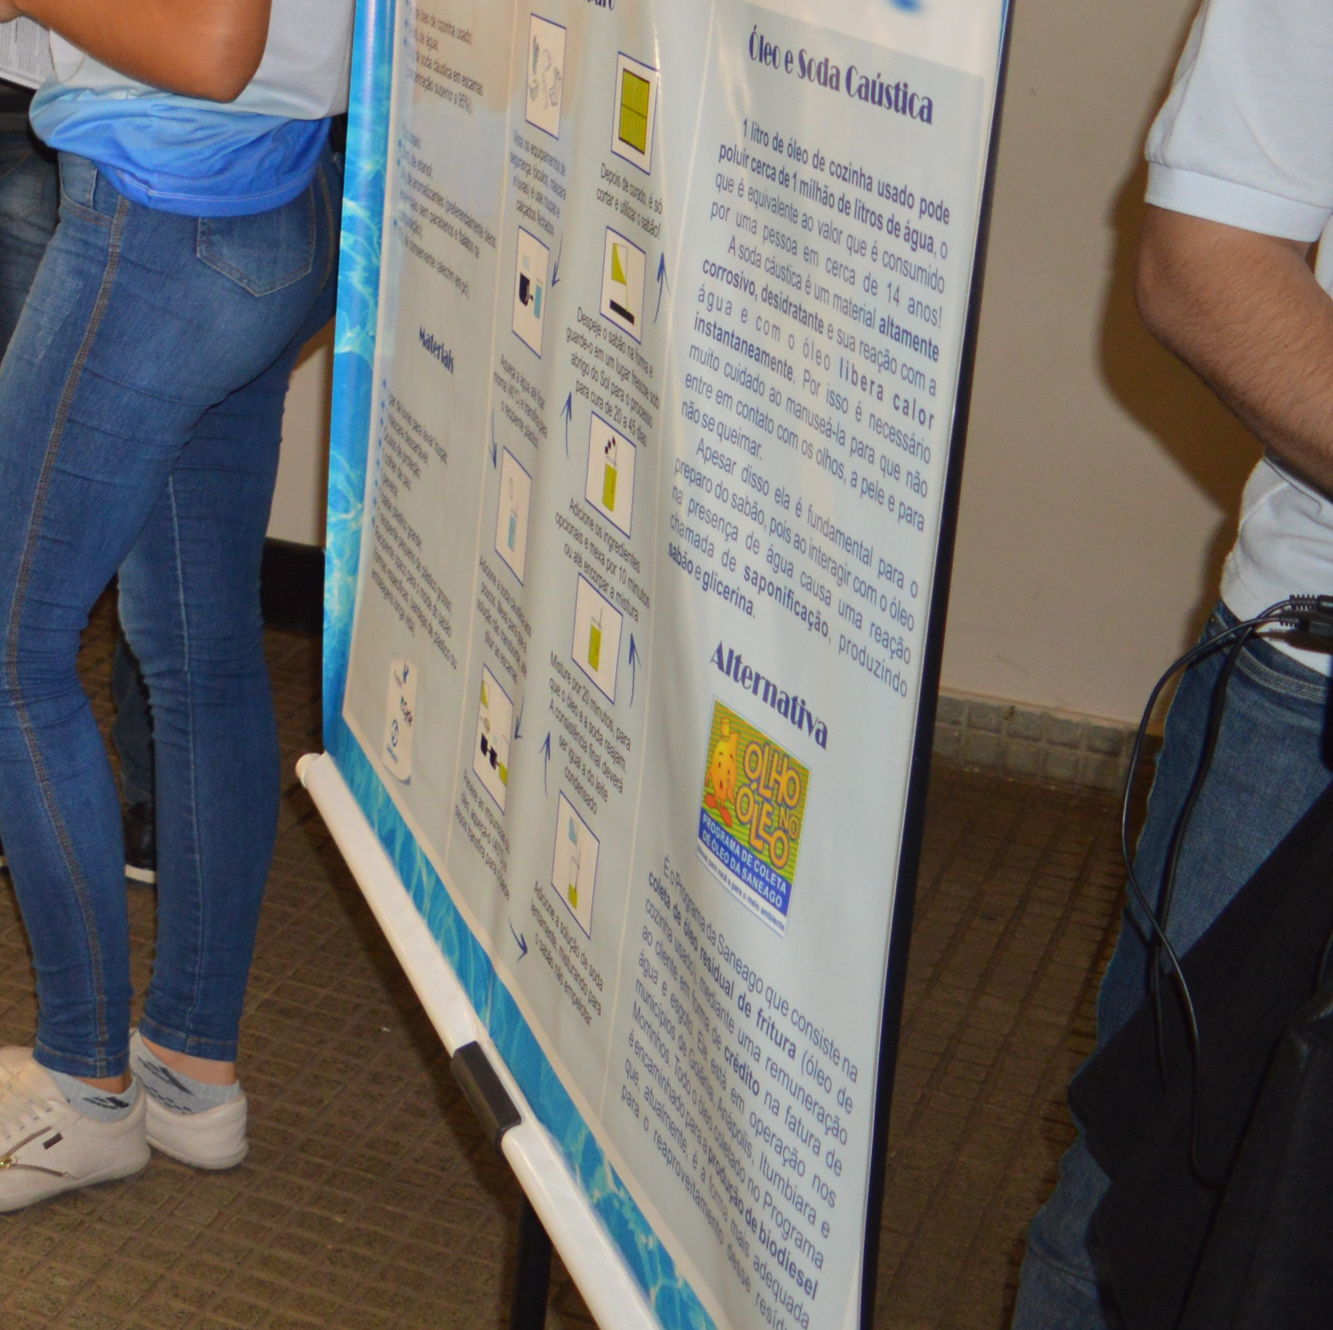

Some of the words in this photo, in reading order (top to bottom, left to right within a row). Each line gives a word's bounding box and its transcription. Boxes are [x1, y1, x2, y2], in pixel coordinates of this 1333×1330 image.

[748, 24, 781, 70] Óleo
[784, 50, 794, 75] e
[797, 47, 840, 92] Soda
[845, 64, 933, 125] Caústica
[718, 143, 750, 169] poluir
[750, 156, 777, 182] cerca
[777, 165, 791, 189] de
[792, 171, 798, 192] 1
[799, 178, 836, 210] milhão
[836, 192, 852, 217] de
[853, 197, 884, 232] litros
[885, 213, 902, 239] de
[903, 219, 937, 258] água,
[939, 241, 948, 260] o
[742, 117, 748, 138] 1
[750, 121, 770, 148] litro
[771, 131, 784, 155] de
[786, 137, 809, 166] óleo
[811, 148, 826, 173] de
[828, 160, 874, 193] cozinha
[877, 179, 915, 210] usado
[918, 196, 951, 226] pode
[709, 201, 731, 222] por
[735, 211, 758, 236] uma
[762, 224, 798, 257] pessoa
[803, 245, 820, 268] em
[825, 256, 856, 287] cerca
[862, 271, 879, 297] de
[886, 281, 901, 308] 14
[907, 296, 943, 329] anos!
[727, 235, 736, 257] A
[738, 244, 762, 269] soda
[764, 255, 803, 291] cáustica
[804, 274, 812, 296] é
[813, 283, 830, 305] um
[832, 293, 877, 330] material
[878, 314, 940, 363] altamente
[419, 325, 454, 374] Materiais
[693, 310, 796, 384] instantaneamente.
[802, 368, 821, 397] Por
[825, 382, 849, 415] isso
[854, 400, 863, 423] é
[868, 413, 931, 465] necessário
[697, 283, 733, 317] água
[740, 307, 748, 325] e
[755, 315, 781, 342] com
[787, 333, 795, 351] o
[802, 337, 831, 372] óleo
[839, 356, 884, 403] libera
[892, 392, 935, 431] calor
[702, 258, 758, 302] corrosivo,
[760, 283, 825, 335] desidratante
[826, 323, 834, 341] e
[836, 328, 856, 353] sua
[859, 340, 898, 375] reação
[900, 362, 926, 391] com
[928, 377, 937, 397] a
[681, 400, 701, 425] não
[700, 412, 716, 433] se
[716, 420, 762, 461] queimar.
[688, 344, 721, 373] muito
[723, 361, 766, 397] cuidado
[768, 386, 783, 407] ao
[785, 396, 847, 447] manuseá-la
[849, 435, 876, 466] para
[879, 454, 902, 482] que
[905, 469, 929, 499] não
[672, 485, 684, 506] na
[687, 497, 739, 543] presença
[745, 530, 761, 556] de
[765, 543, 795, 578] água
[799, 570, 832, 608] causa
[837, 598, 863, 631] uma
[869, 621, 912, 666] reação
[695, 437, 738, 476] Apesar
[740, 463, 770, 497] disso
[774, 485, 791, 511] ela
[794, 496, 803, 519] é
[806, 503, 874, 568] fundamental
[877, 557, 905, 590] para
[909, 579, 919, 599] o
[668, 542, 694, 576] sabão
[694, 564, 702, 582] e
[701, 569, 756, 619] glicerina.
[670, 512, 715, 559] chamada
[720, 551, 737, 573] de
[743, 565, 832, 644] saponificação,
[838, 633, 908, 698] produzindo
[709, 640, 828, 750] Alternativa
[734, 782, 790, 870] ÓLEO
[743, 739, 801, 809] OLHO
[778, 805, 800, 841] NO
[702, 813, 740, 857] PROGRAMA
[741, 847, 752, 868] DE
[753, 857, 786, 895] COLETA
[702, 828, 710, 846] DE
[711, 836, 729, 864] ÓLEO
[730, 856, 740, 875] DA
[741, 865, 782, 910] SANEAGO
[645, 898, 673, 944] cozinha
[674, 936, 697, 983] usado),
[699, 976, 735, 1035] mediante
[737, 1027, 762, 1064] uma
[764, 1055, 848, 1147] remuneração
[648, 871, 671, 911] coleta
[672, 902, 682, 927] de
[683, 917, 699, 952] óleo
[699, 946, 735, 1001] residual
[737, 992, 752, 1019] de
[755, 1007, 797, 1061] fritura
[800, 1049, 833, 1094] (óleo
[836, 1086, 853, 1115] de
[628, 1028, 635, 1048] é
[634, 1040, 686, 1119] encaminhado
[684, 1110, 703, 1145] para
[702, 1137, 708, 1155] a
[707, 1146, 745, 1216] produção
[744, 1207, 758, 1234] de
[758, 1220, 819, 1301] biodiesel
